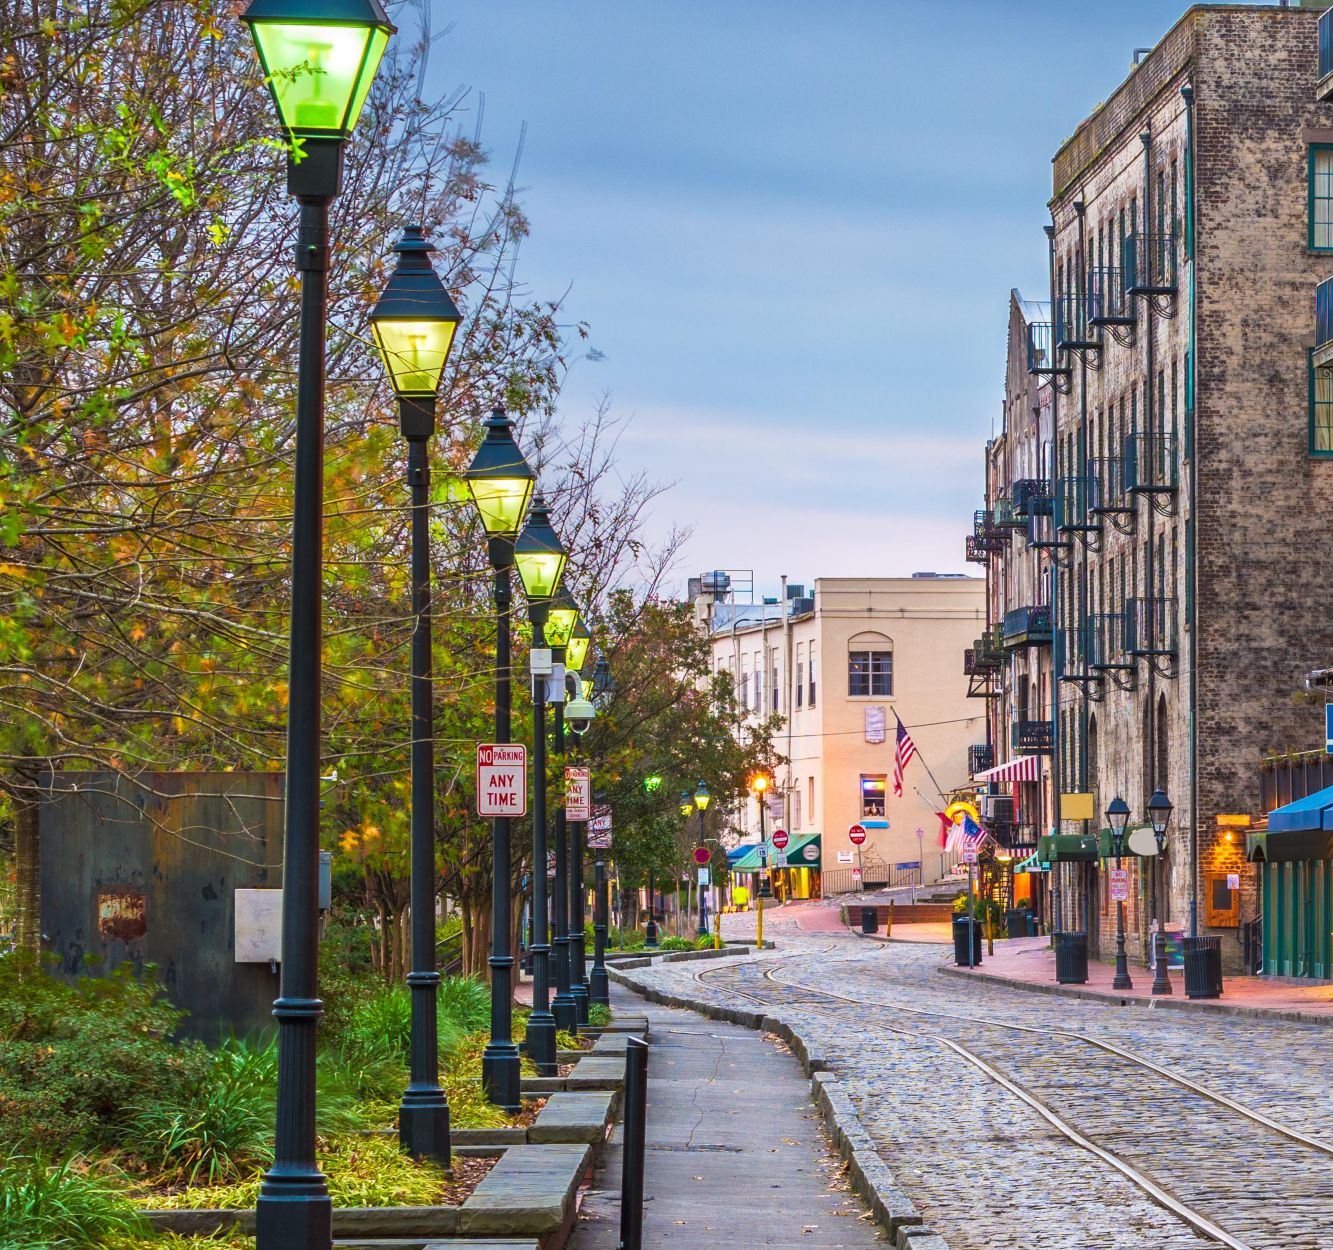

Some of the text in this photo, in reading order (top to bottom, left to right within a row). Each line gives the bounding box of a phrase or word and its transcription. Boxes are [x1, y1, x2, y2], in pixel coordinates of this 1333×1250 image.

[480, 749, 523, 763] NO PARKING
[489, 775, 515, 787] ANY
[567, 785, 583, 793] ANY
[487, 793, 517, 806] TIME
